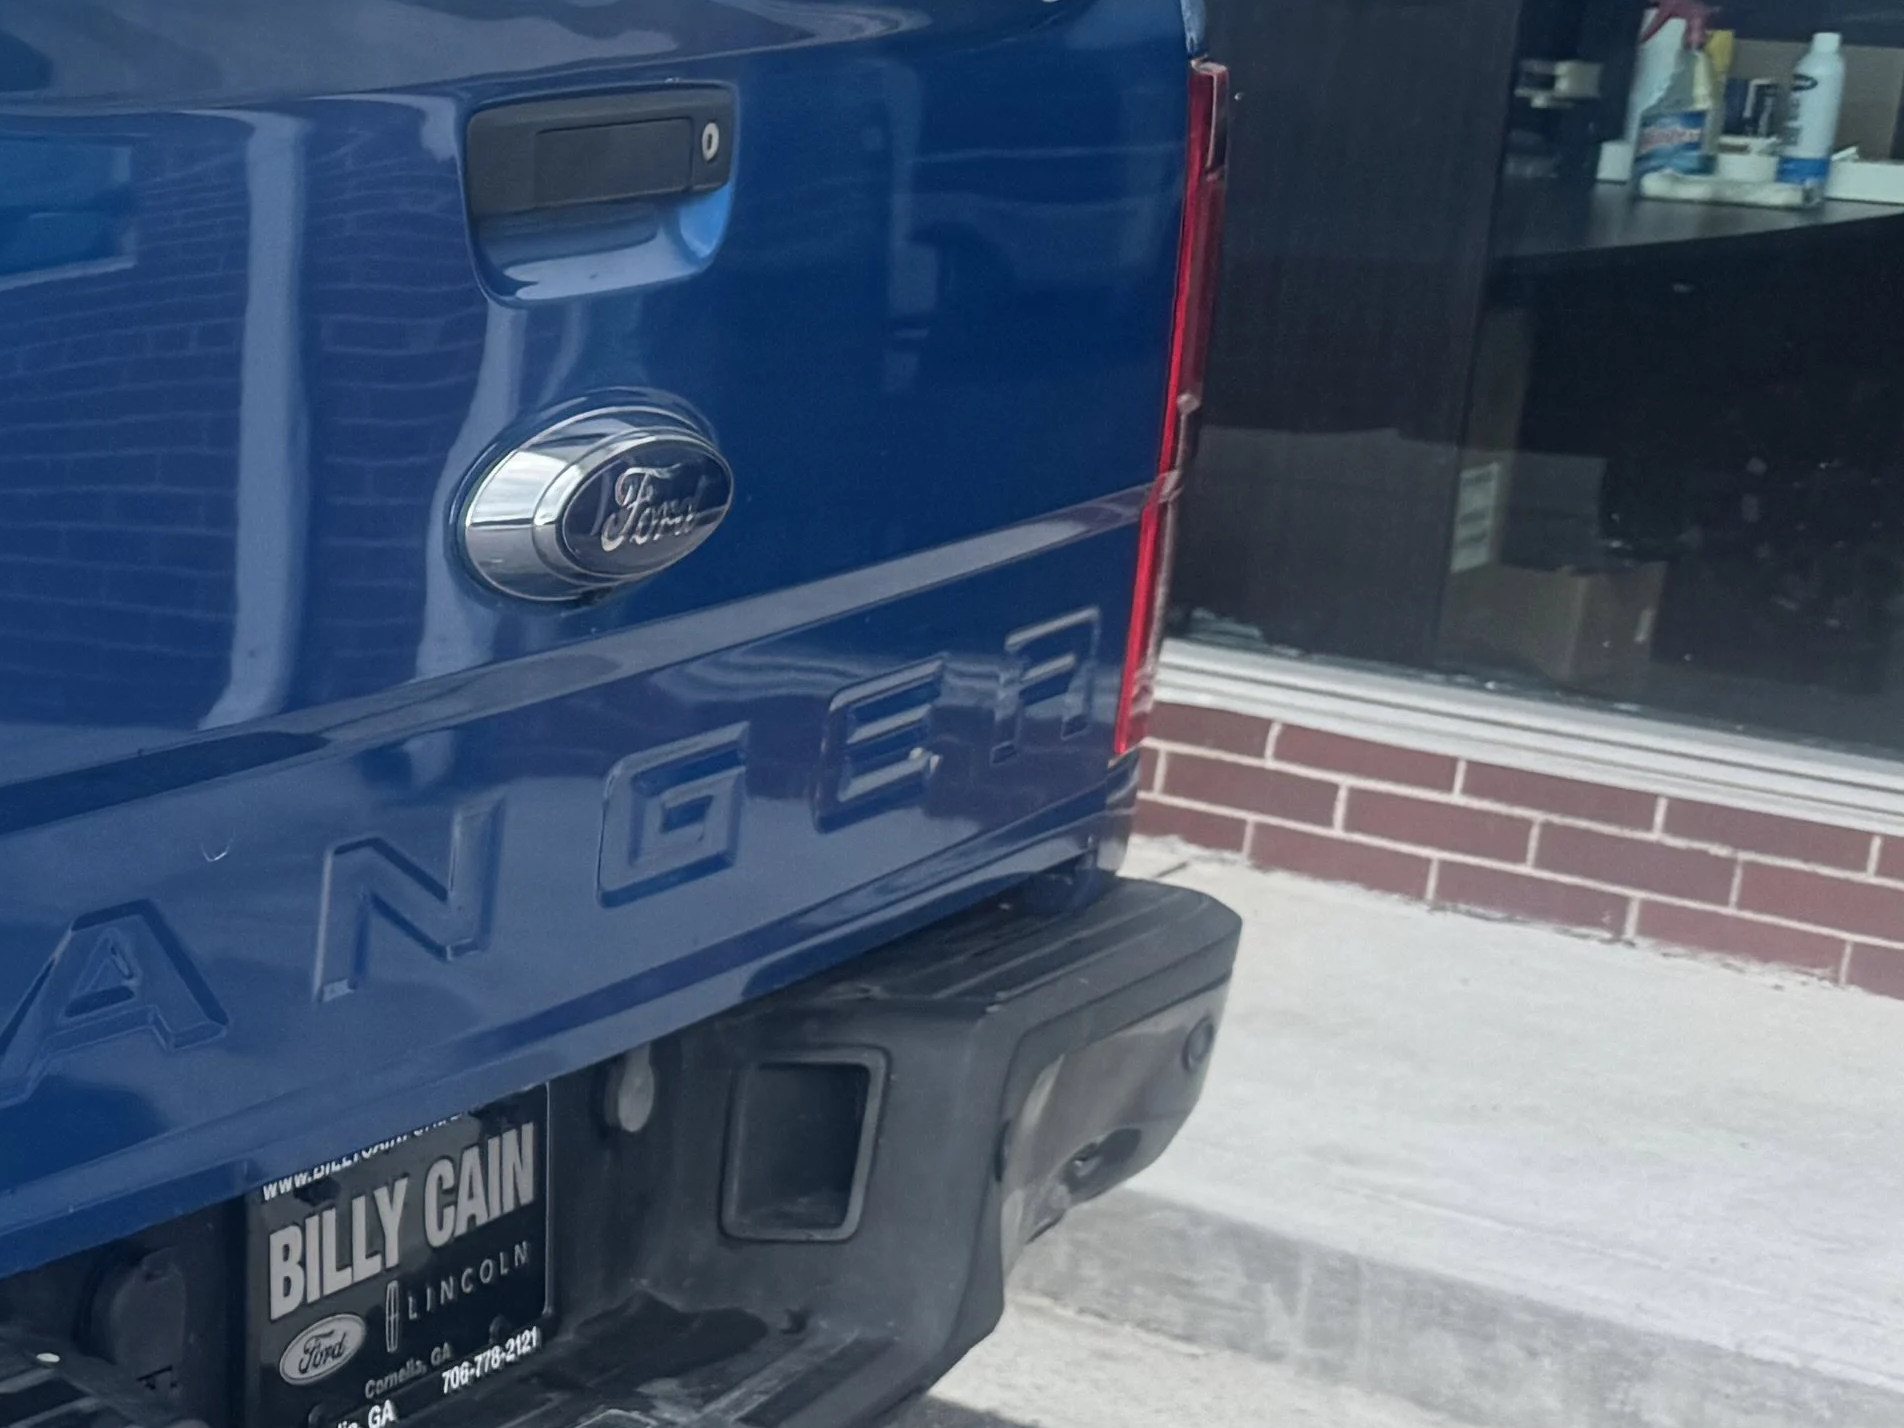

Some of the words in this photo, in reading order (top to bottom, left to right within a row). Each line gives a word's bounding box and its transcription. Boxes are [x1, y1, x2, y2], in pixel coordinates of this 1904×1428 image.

[601, 462, 704, 553] Ford
[270, 1177, 408, 1320] BILLY
[424, 1121, 535, 1248] CAIN
[298, 1329, 347, 1374] Ford
[407, 1240, 530, 1320] LINCOLN
[431, 1342, 452, 1366] GA
[442, 1325, 538, 1394] 706-778-2121
